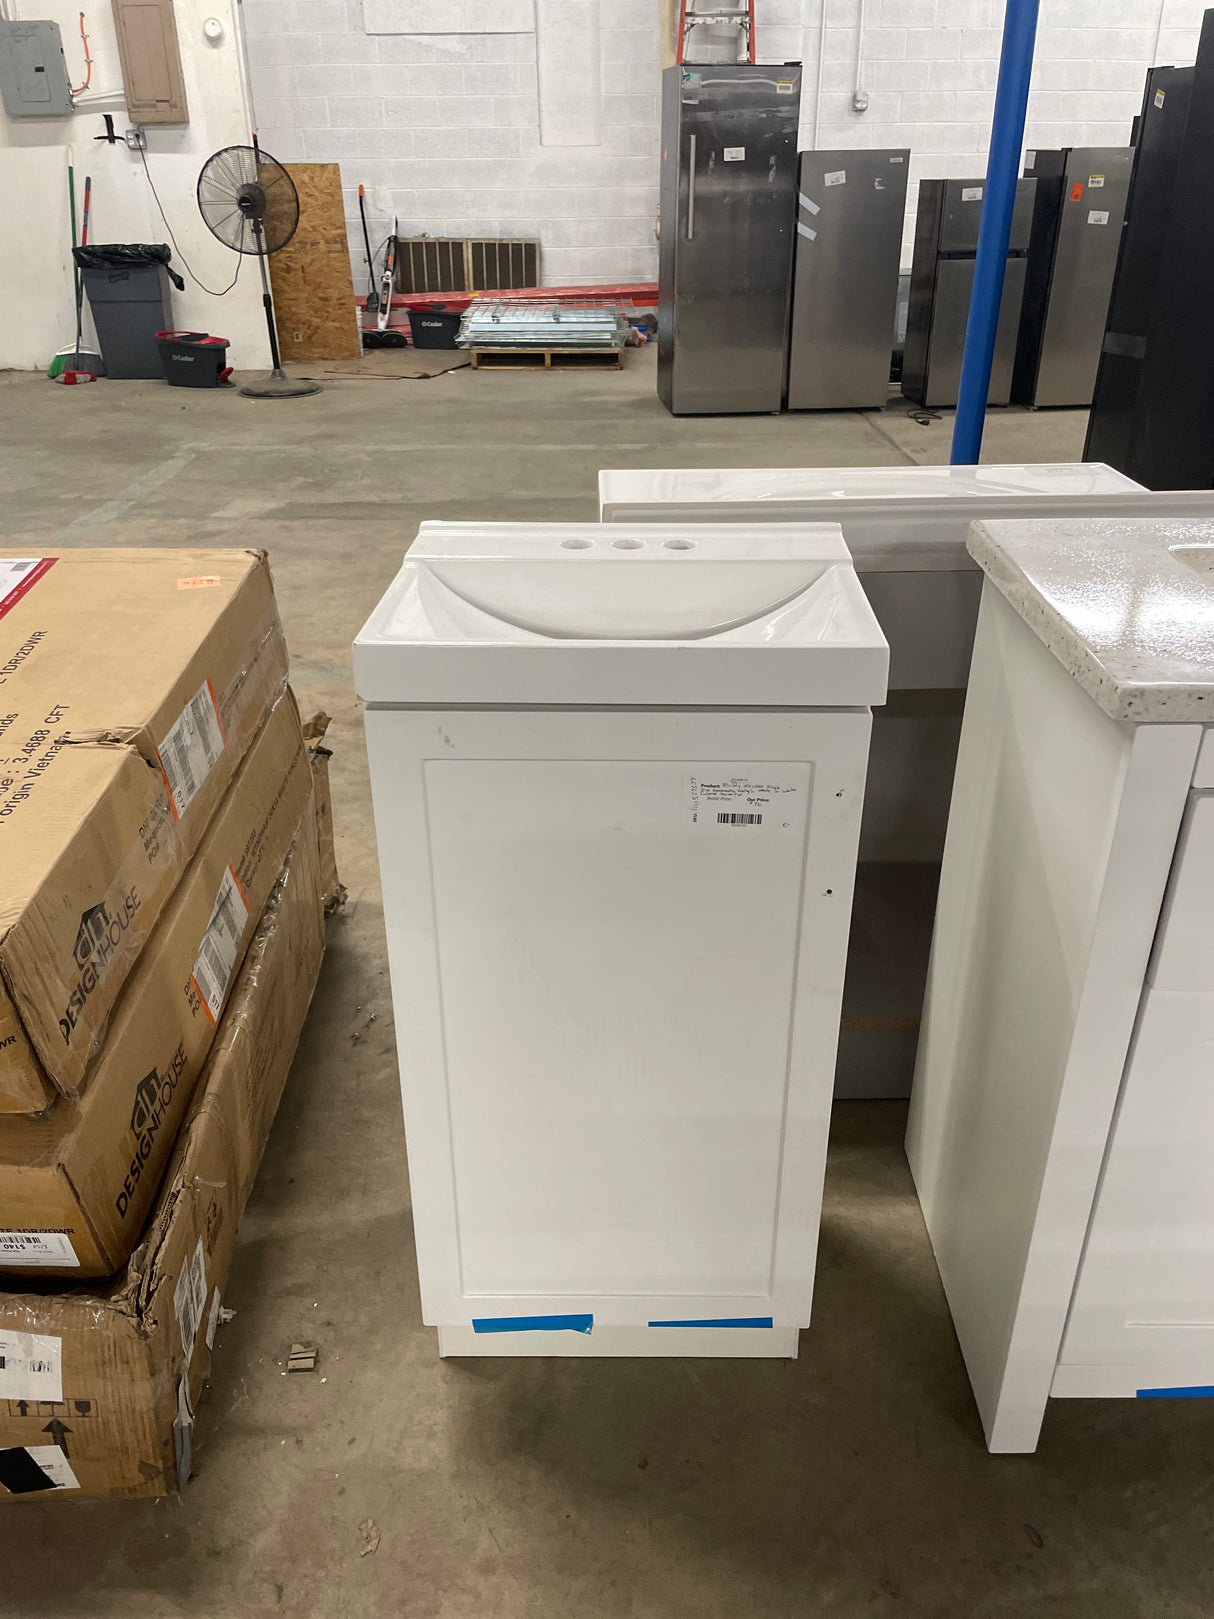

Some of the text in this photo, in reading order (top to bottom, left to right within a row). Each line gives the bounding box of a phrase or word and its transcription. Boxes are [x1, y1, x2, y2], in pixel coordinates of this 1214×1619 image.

[12, 729, 51, 764] 3.4688
[44, 704, 70, 724] CFT
[0, 782, 35, 817] origin
[58, 886, 141, 1046] DESIGNHOUSE
[115, 1041, 188, 1219] DESIGNHOUSE
